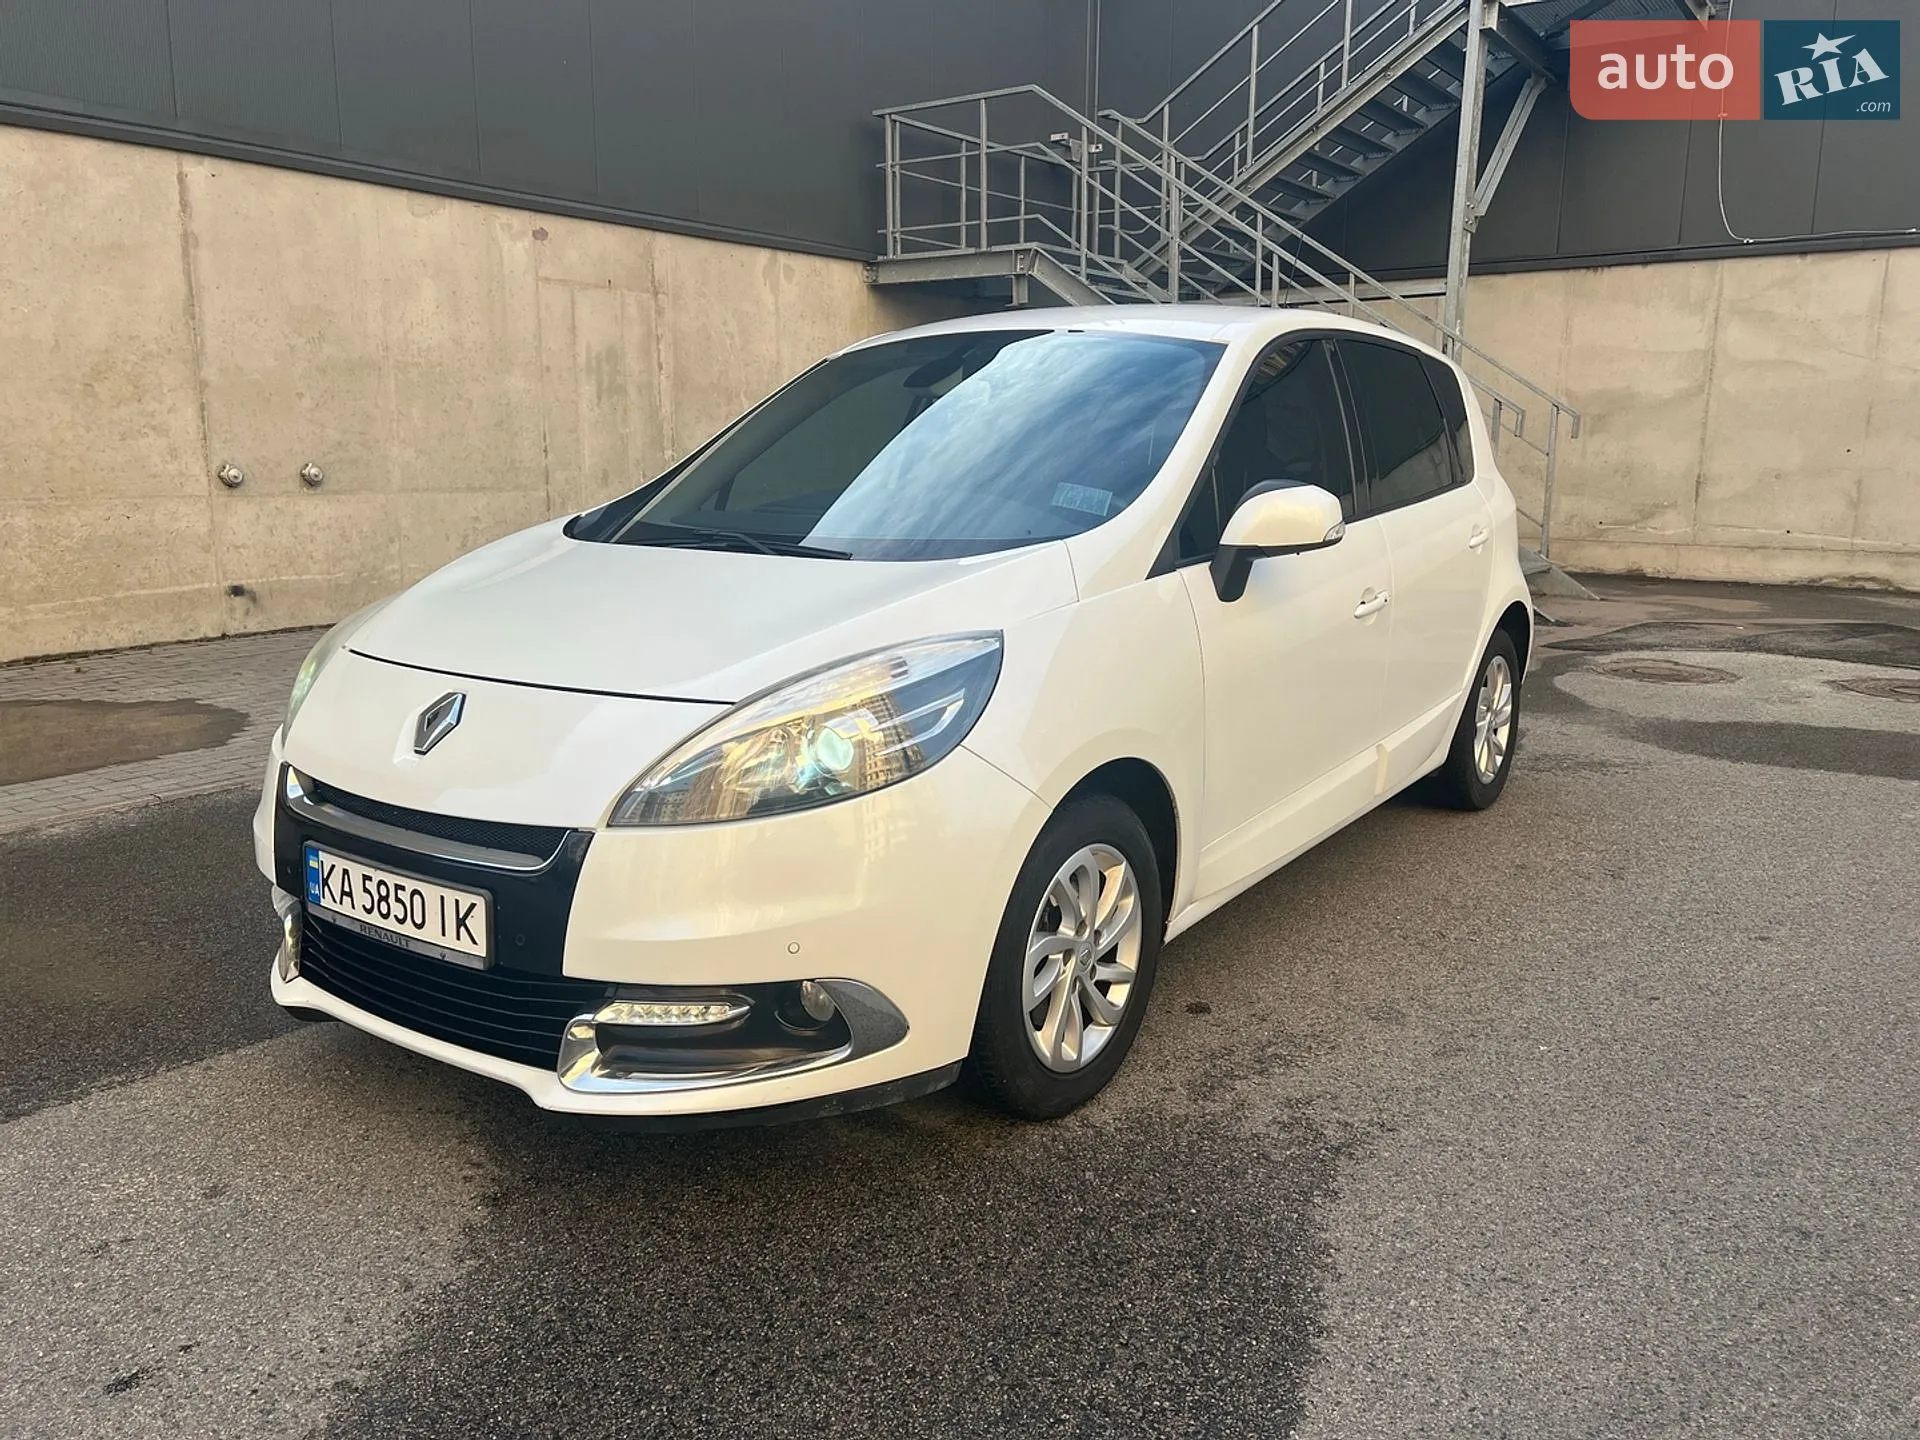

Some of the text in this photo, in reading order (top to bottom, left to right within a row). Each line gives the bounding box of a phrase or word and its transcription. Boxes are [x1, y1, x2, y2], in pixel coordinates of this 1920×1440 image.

[320, 860, 479, 946] KA 5850 IK
[360, 923, 410, 948] RENAULT
